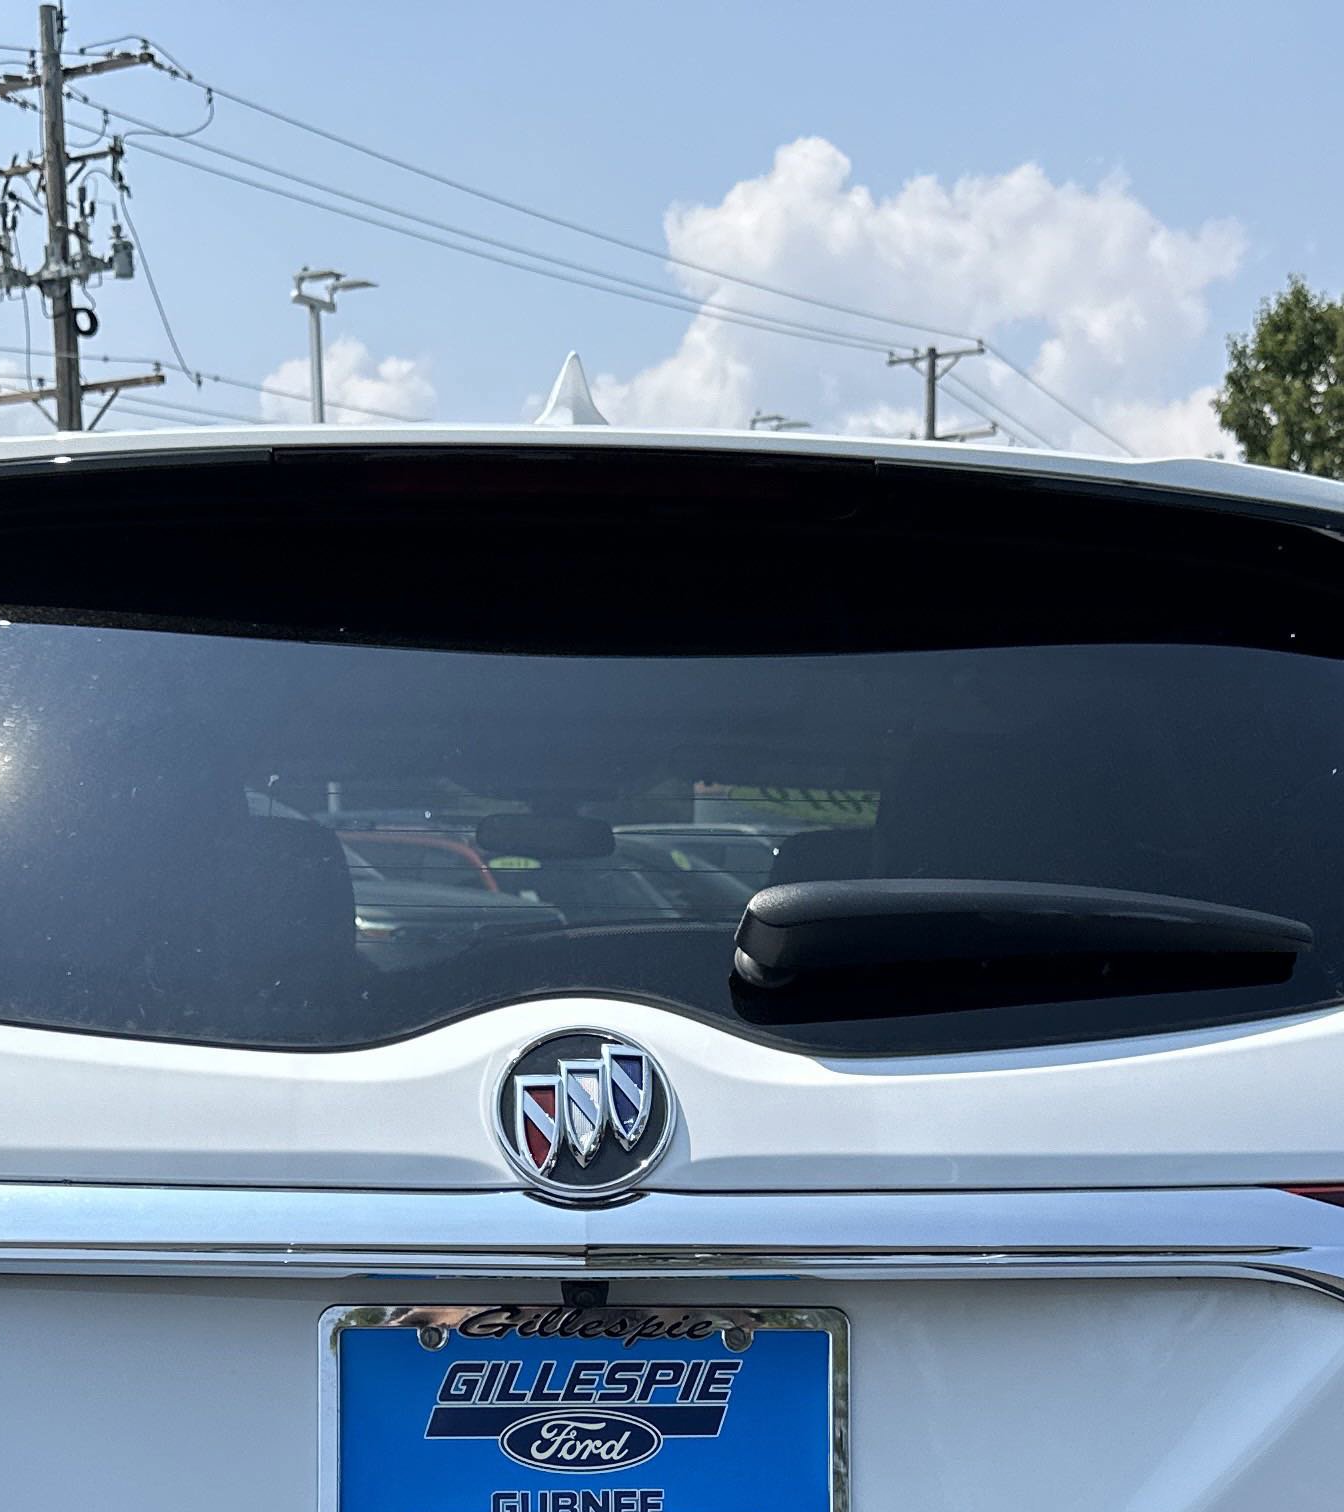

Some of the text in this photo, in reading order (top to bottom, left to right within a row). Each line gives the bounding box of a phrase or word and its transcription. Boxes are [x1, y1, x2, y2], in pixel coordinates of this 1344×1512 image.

[458, 1305, 714, 1349] Gillespie
[435, 1359, 744, 1404] GILLESPIE
[530, 1420, 631, 1462] Ford
